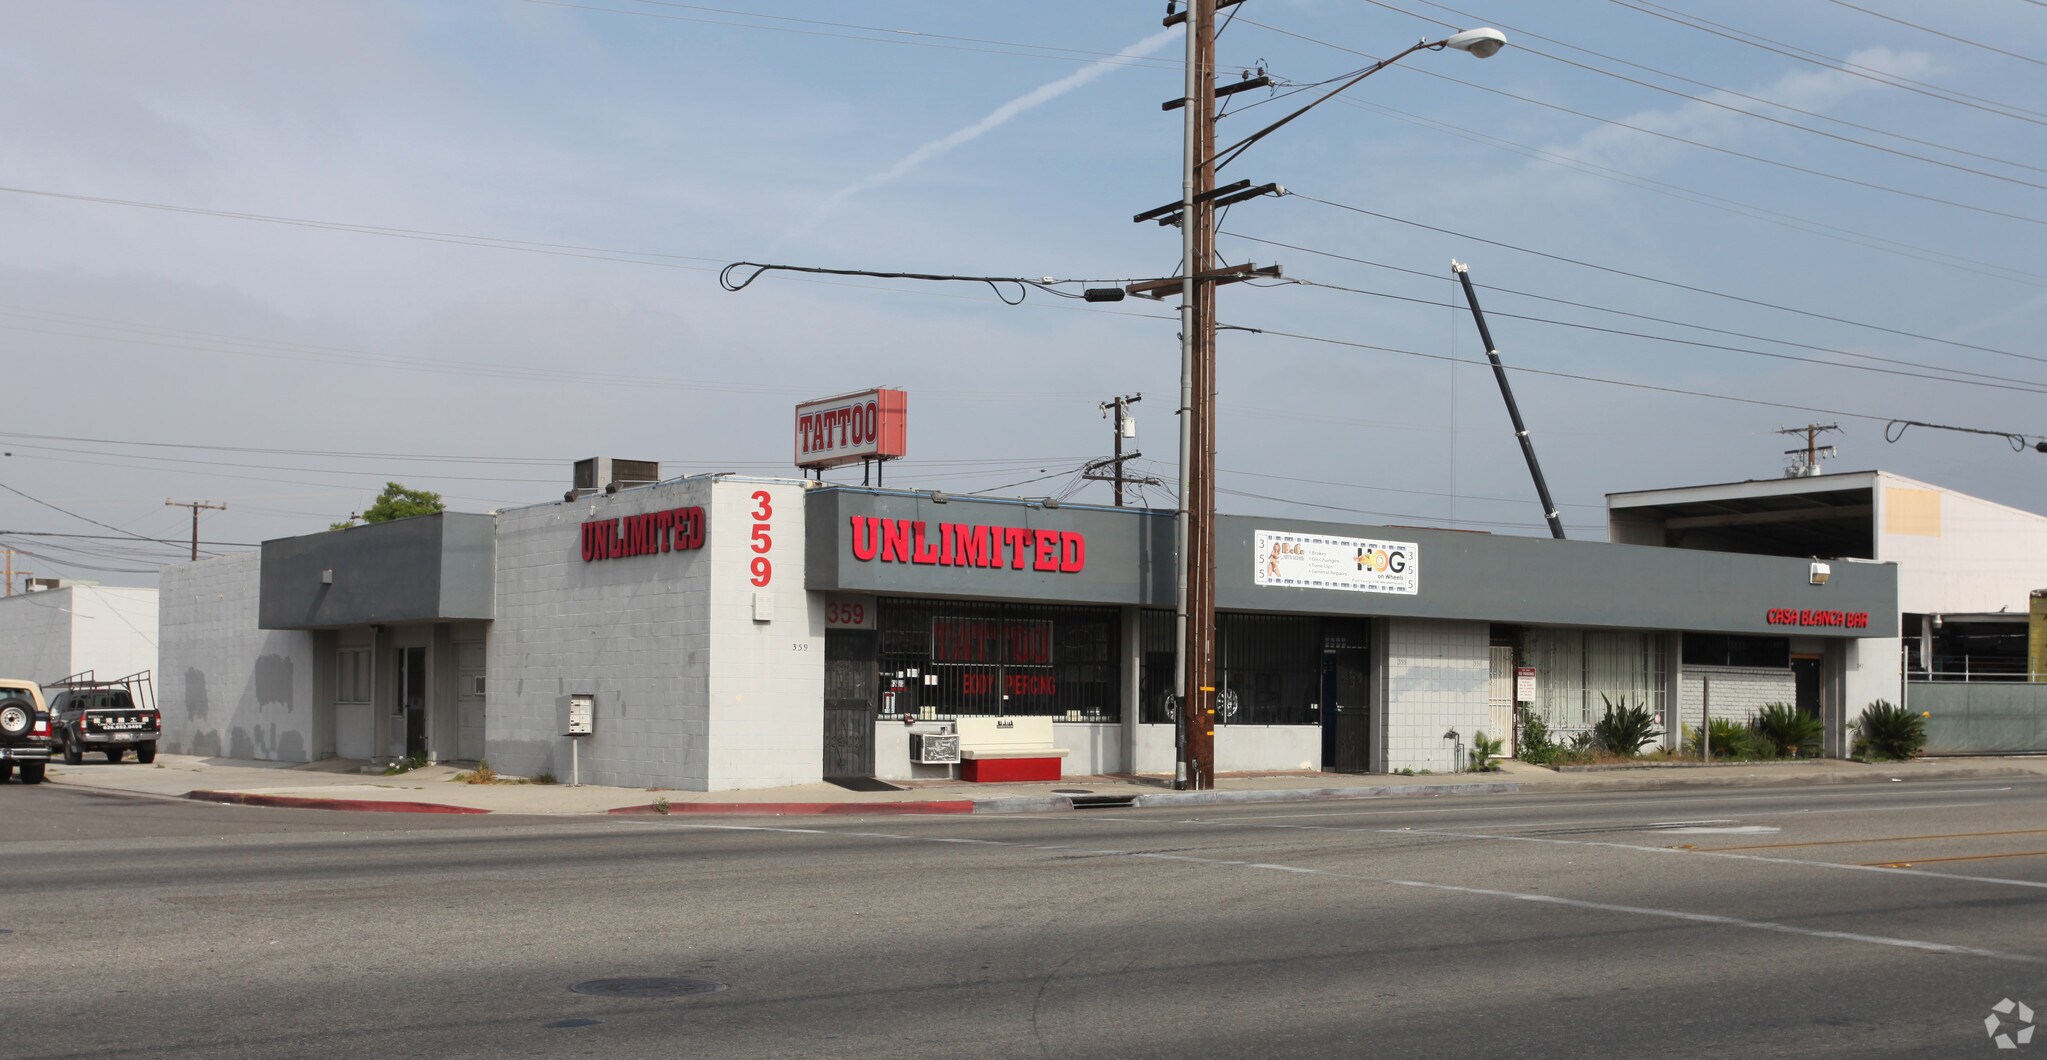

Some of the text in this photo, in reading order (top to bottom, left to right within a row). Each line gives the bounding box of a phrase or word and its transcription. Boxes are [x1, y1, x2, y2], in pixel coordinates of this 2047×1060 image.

[799, 400, 878, 456] TATTOO
[581, 506, 706, 562] UNLIMITED
[750, 490, 773, 588] 359
[851, 515, 1086, 573] UNLIMITED
[827, 602, 864, 625] 359
[1767, 608, 1869, 628] CASA BLANCA BAR
[792, 643, 809, 651] 359
[962, 673, 1056, 696] BODY PIERCING
